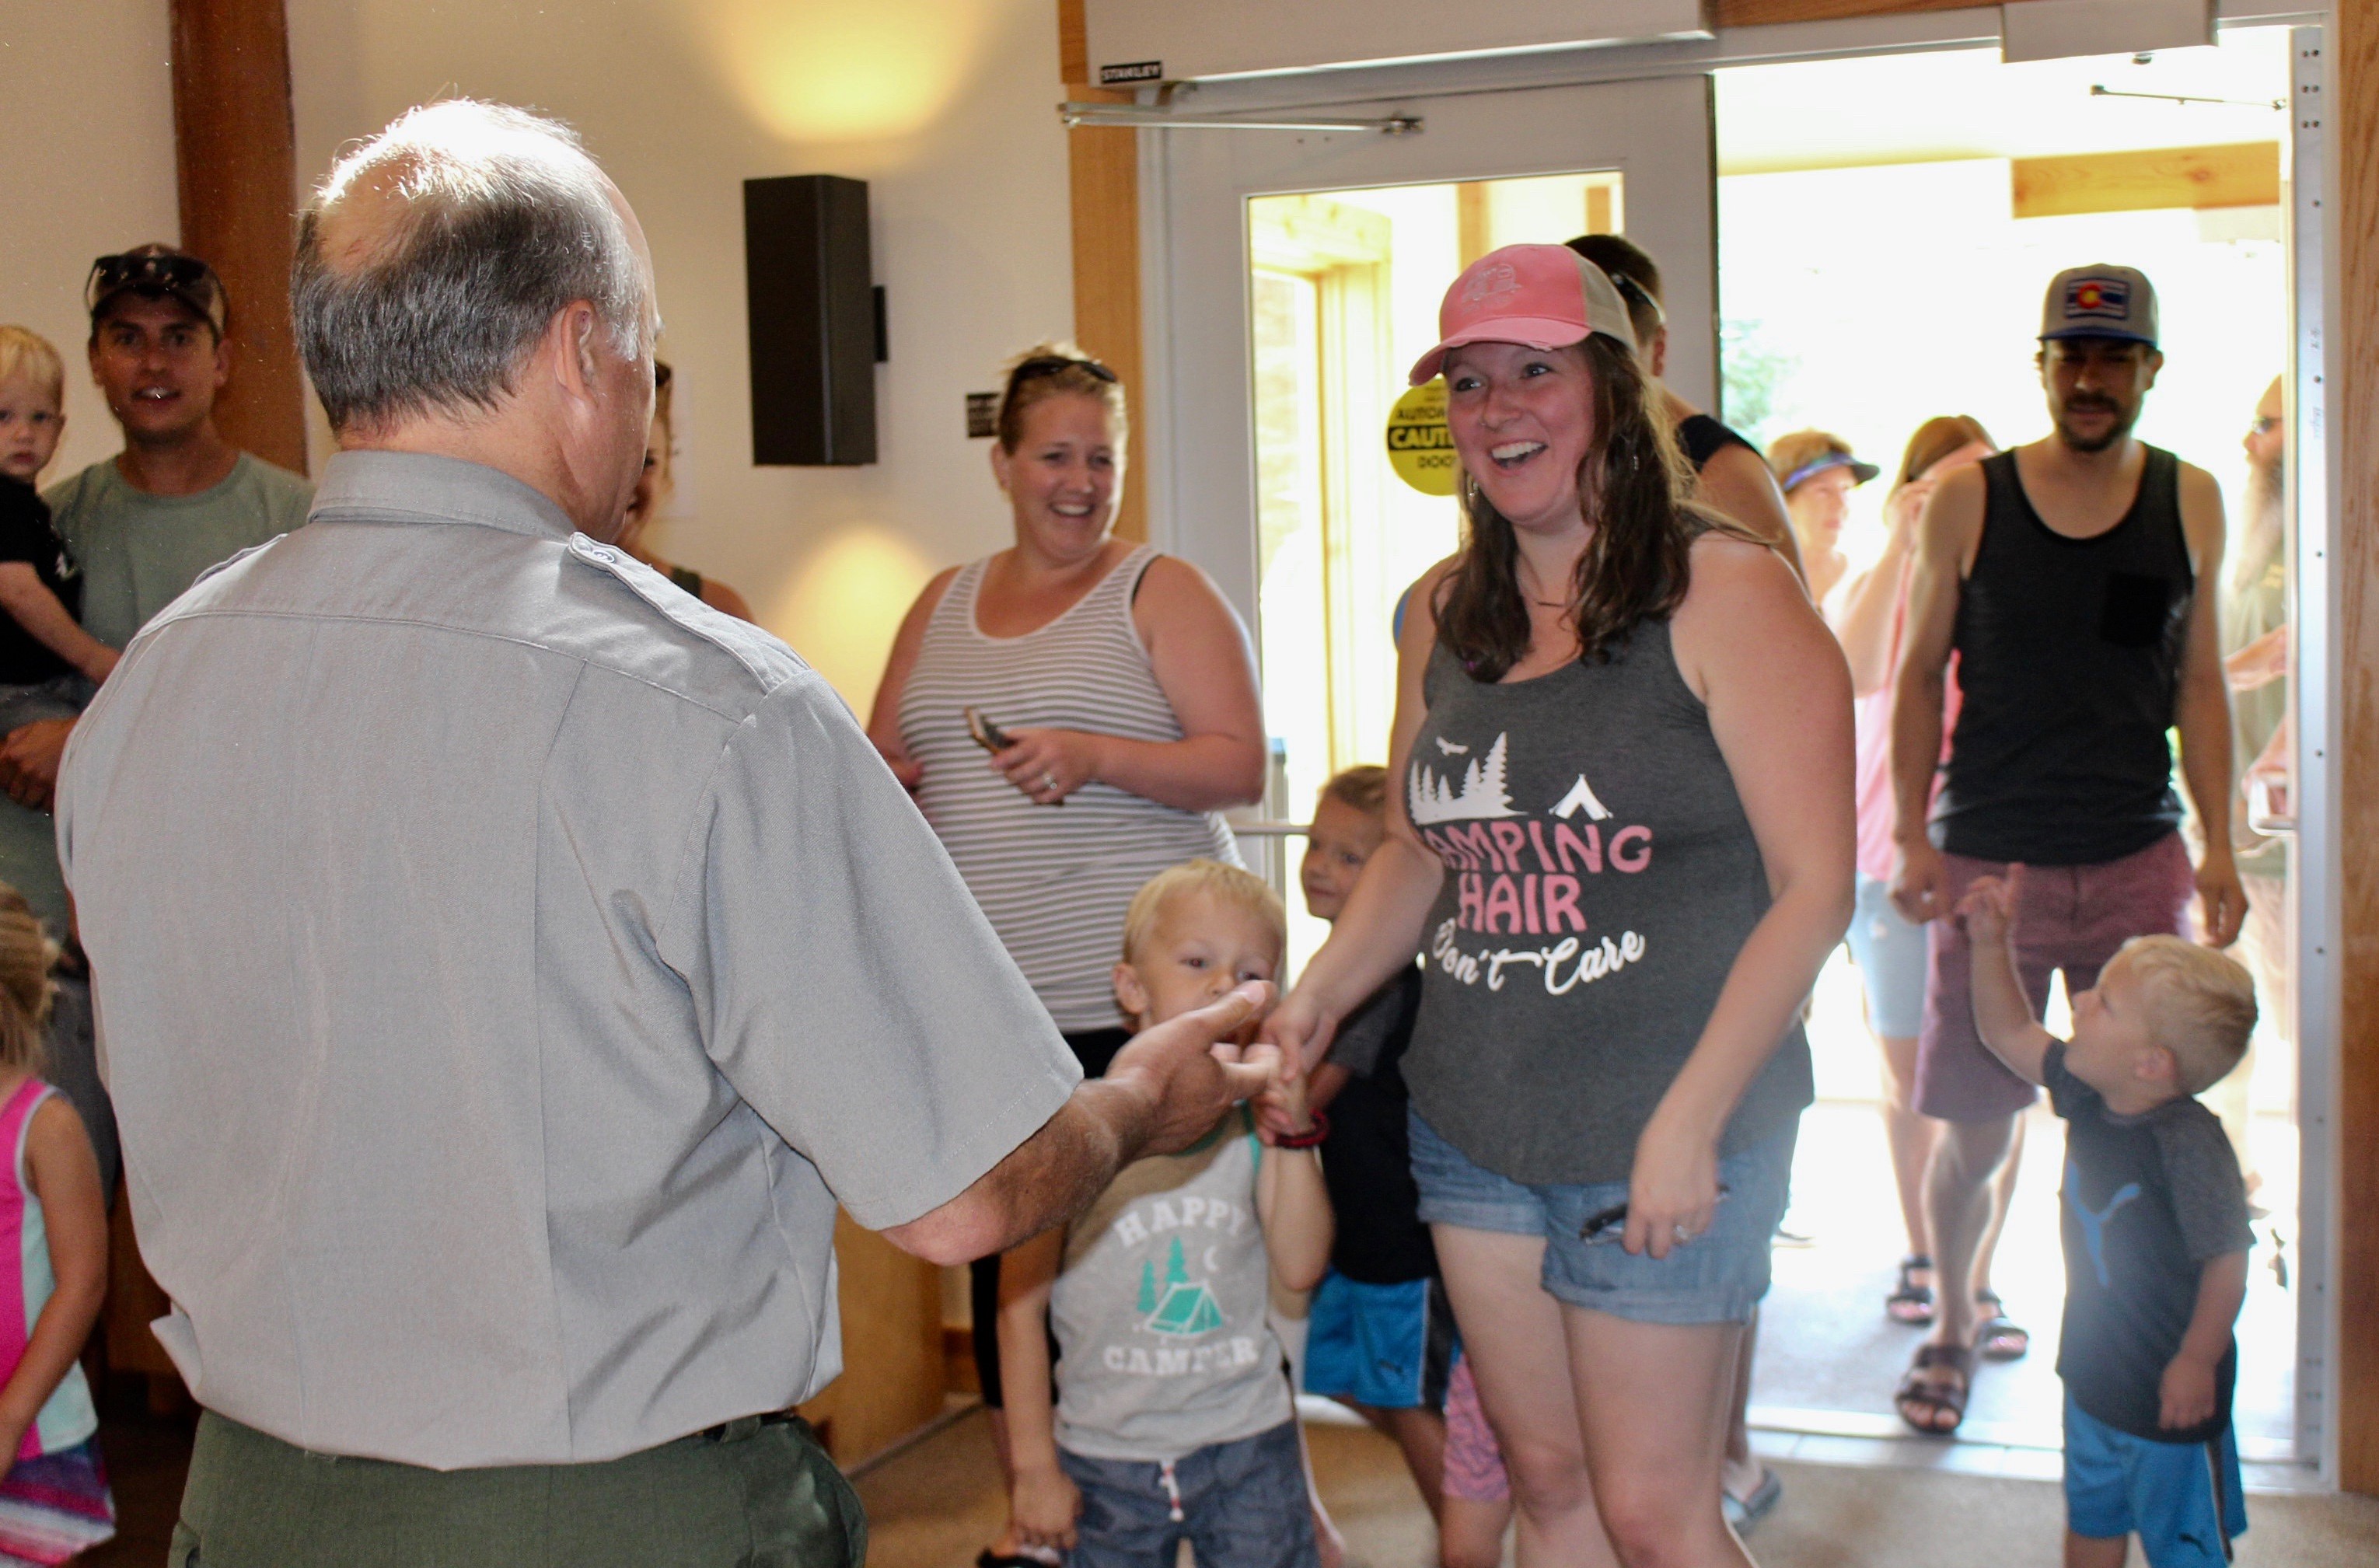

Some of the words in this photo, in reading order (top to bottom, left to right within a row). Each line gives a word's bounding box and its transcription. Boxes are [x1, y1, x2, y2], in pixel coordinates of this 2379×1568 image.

[1418, 456, 1455, 468] DOO
[1424, 820, 1653, 873] AMPING
[1457, 873, 1588, 934] HAIR
[1432, 917, 1543, 991] Don't
[1541, 930, 1646, 996] Care
[1114, 1196, 1245, 1248] HAPPY
